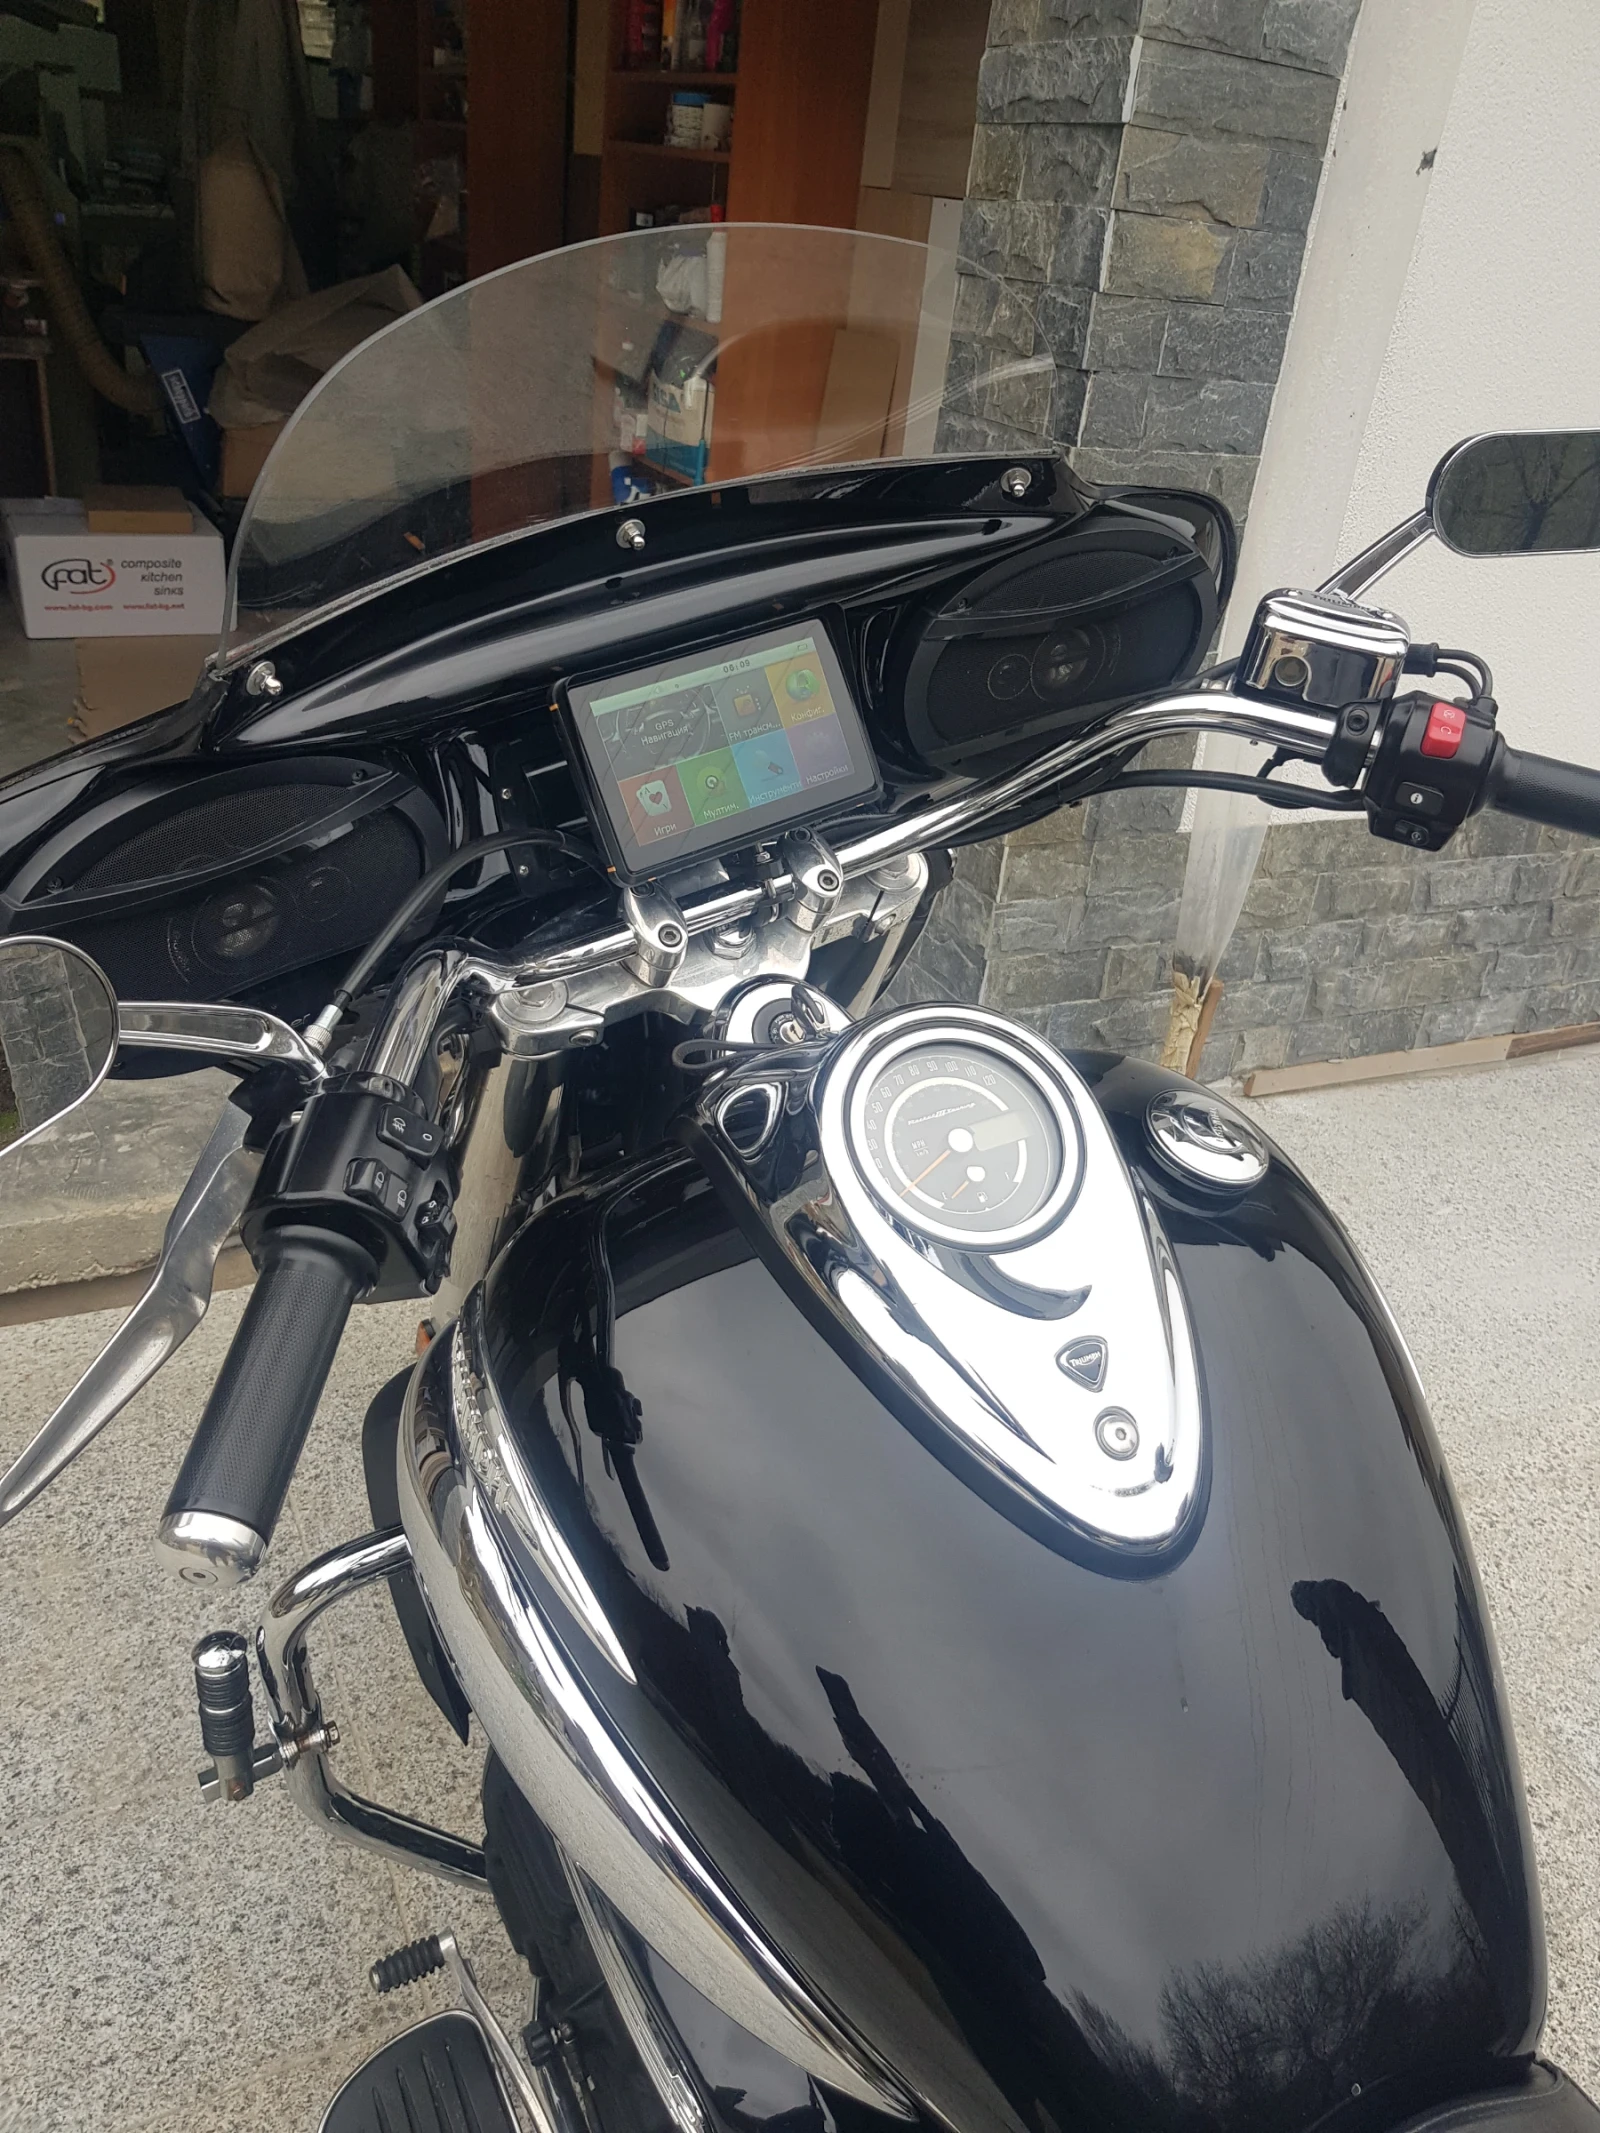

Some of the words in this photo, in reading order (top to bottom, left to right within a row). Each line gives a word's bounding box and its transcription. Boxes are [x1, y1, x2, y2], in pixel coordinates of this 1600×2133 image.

[120, 558, 182, 569] composite
[140, 572, 183, 582] kitchen
[154, 586, 184, 596] sinks
[655, 719, 674, 731] GPS
[641, 725, 689, 746] Навигация
[728, 731, 742, 742] FM
[653, 823, 677, 836] Игри
[908, 1064, 920, 1077] 80
[926, 1060, 939, 1072] 90
[944, 1060, 959, 1073] 100
[964, 1065, 977, 1077] 110
[893, 1074, 905, 1086] 70
[982, 1074, 997, 1087] 120
[880, 1086, 892, 1098] 60
[871, 1101, 884, 1114] 50
[866, 1119, 877, 1131] 40
[911, 1139, 926, 1150] MPH
[1068, 1351, 1101, 1367] TRIUMPH
